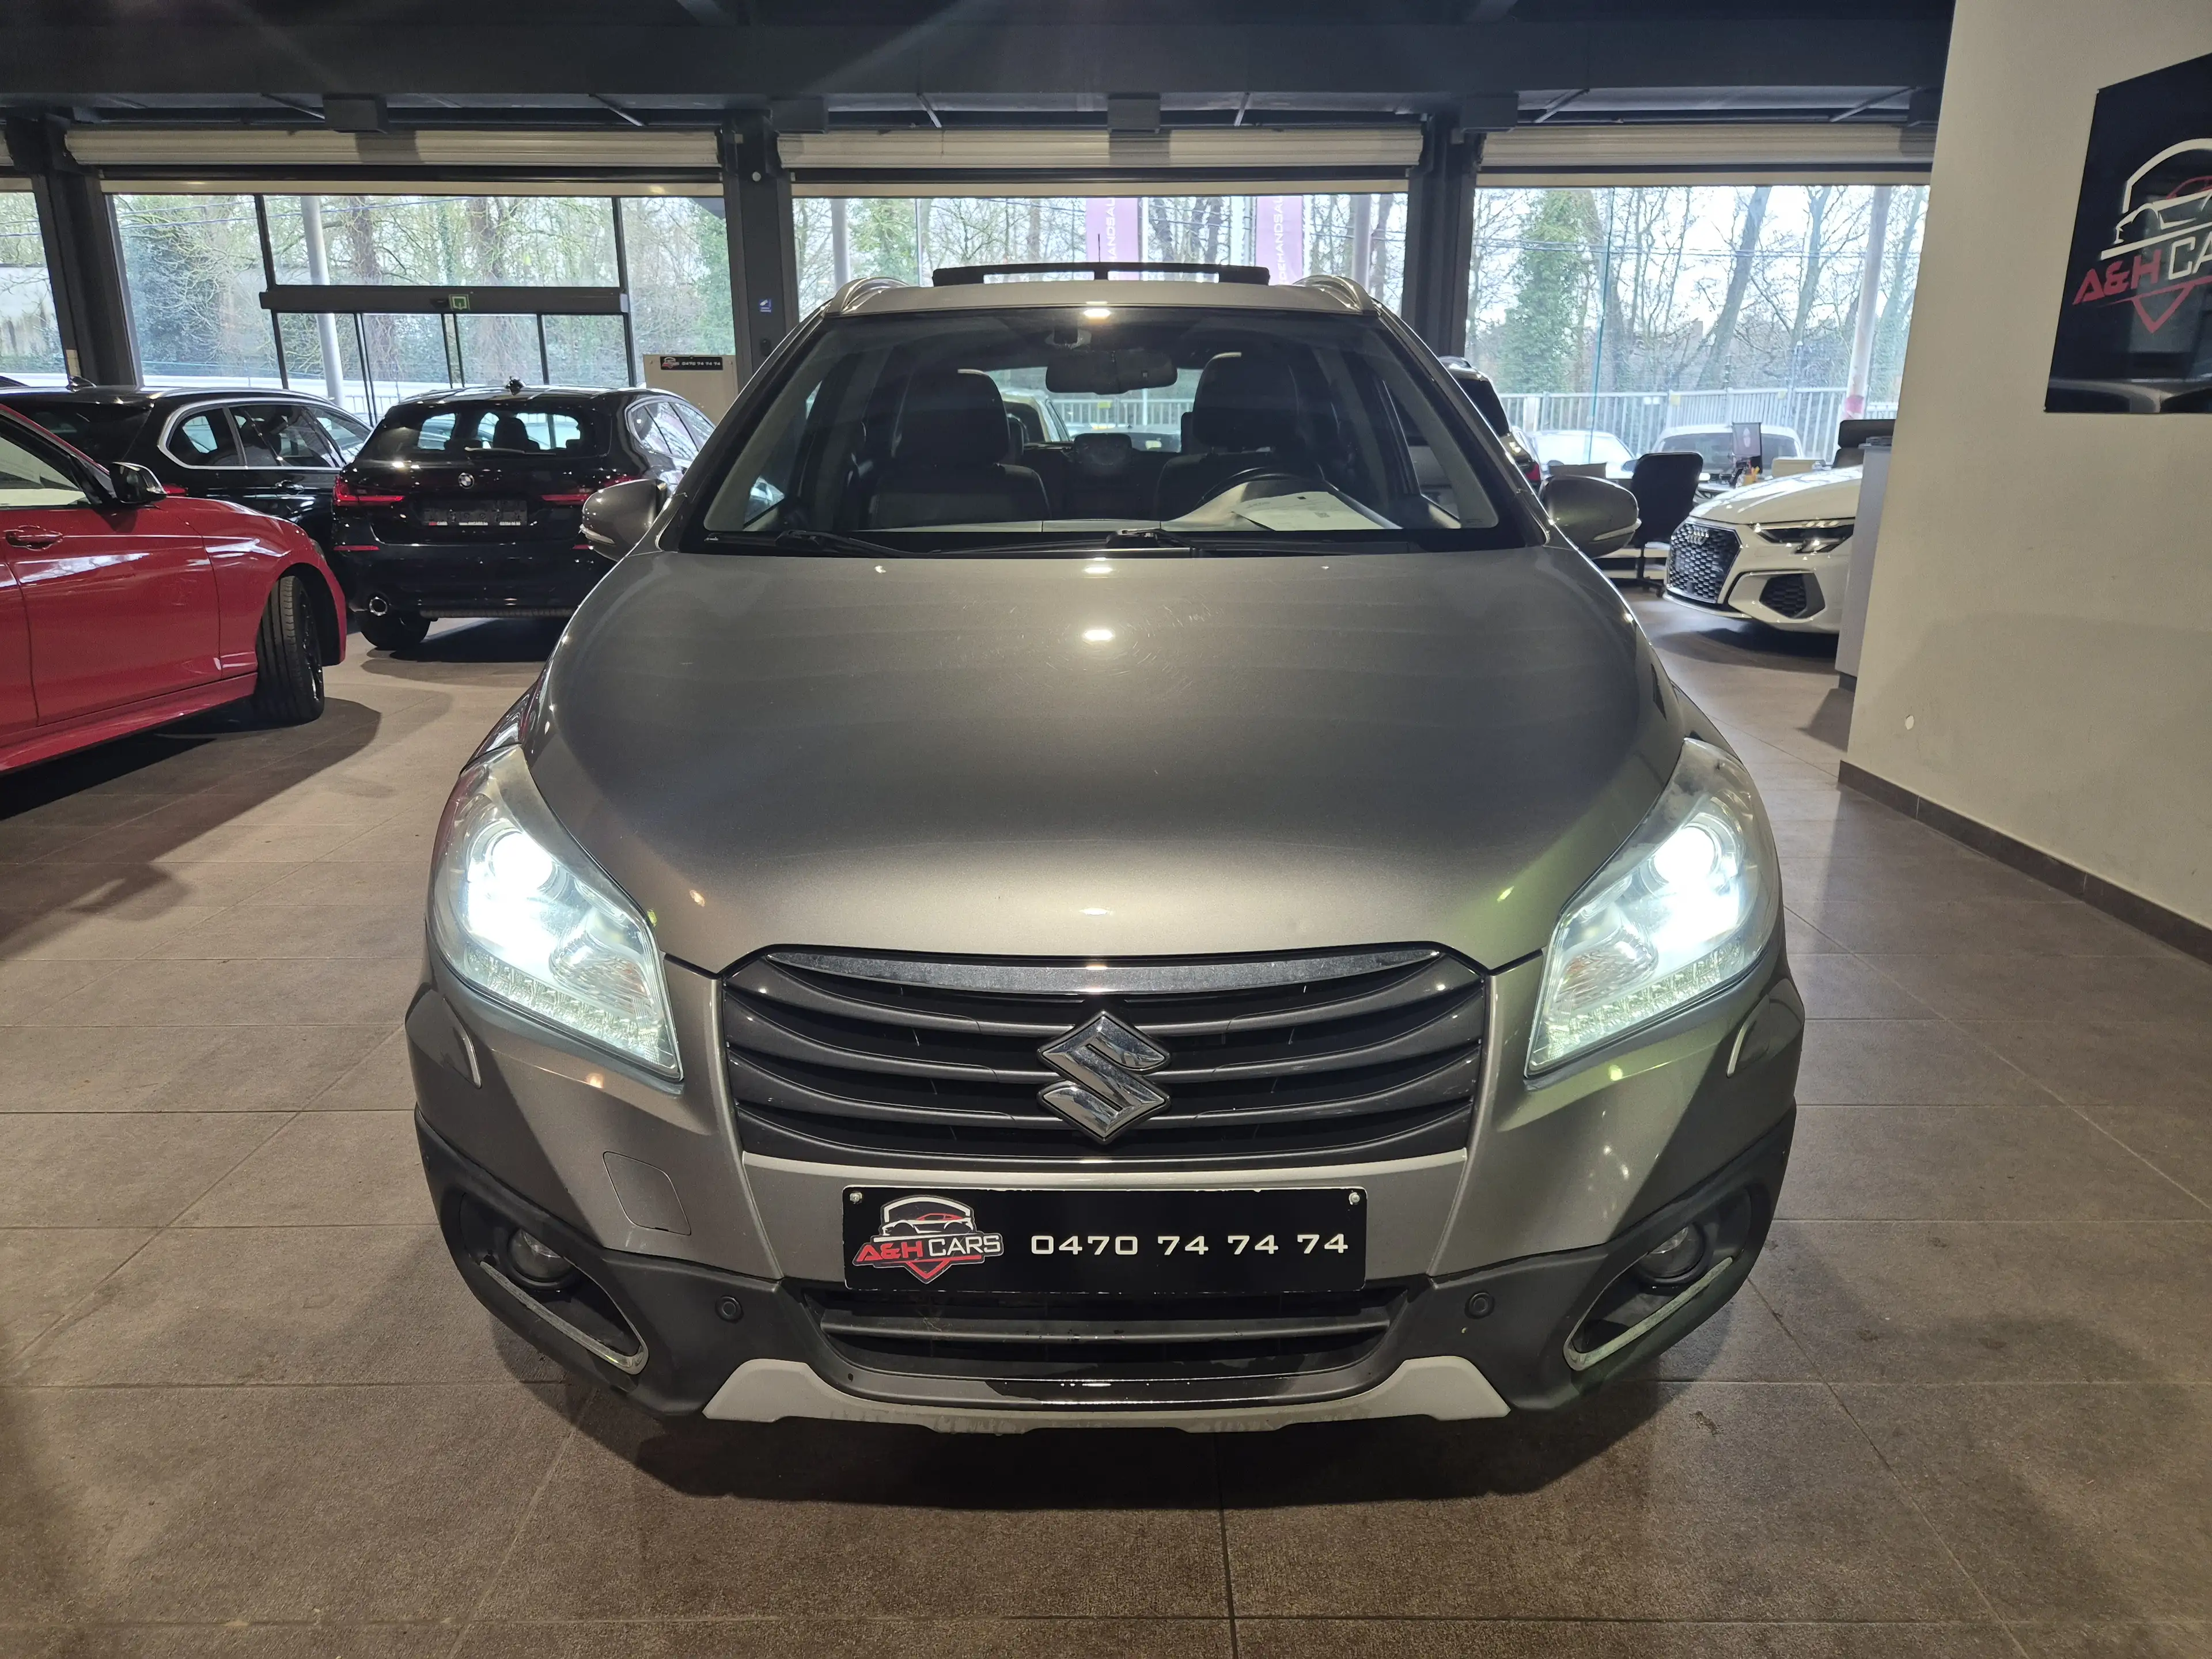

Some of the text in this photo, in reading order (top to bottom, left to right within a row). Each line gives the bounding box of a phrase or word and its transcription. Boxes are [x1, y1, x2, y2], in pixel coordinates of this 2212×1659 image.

[2073, 249, 2162, 305] A&H
[857, 1235, 1001, 1262] A&H CARS
[1031, 1233, 1349, 1255] 0470 74 74 74
